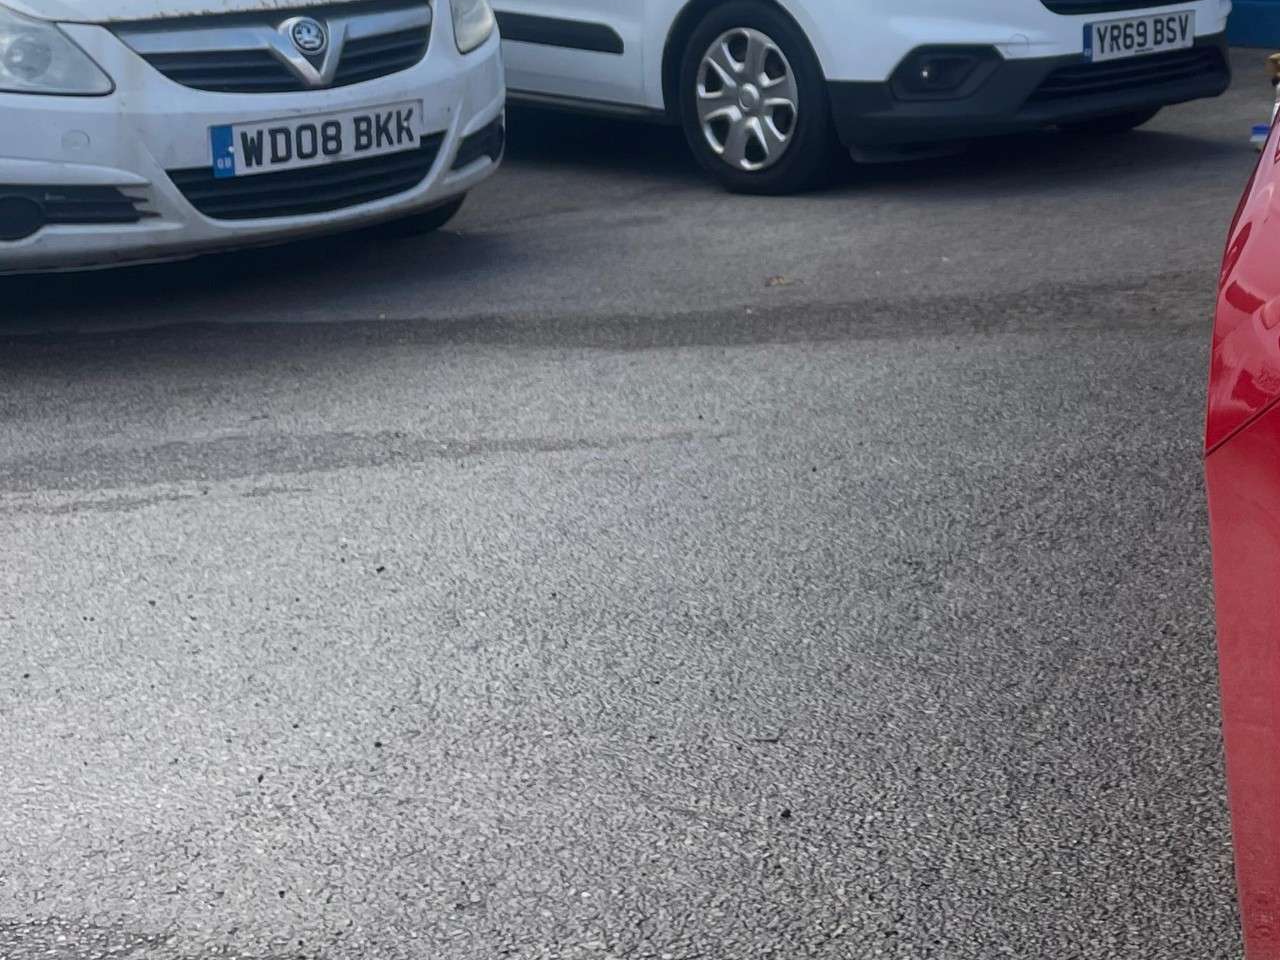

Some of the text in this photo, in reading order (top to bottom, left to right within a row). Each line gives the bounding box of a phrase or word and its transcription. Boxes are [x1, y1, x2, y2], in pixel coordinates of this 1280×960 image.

[1096, 14, 1189, 54] YR69 BSV
[240, 108, 414, 167] WD08 BKK
